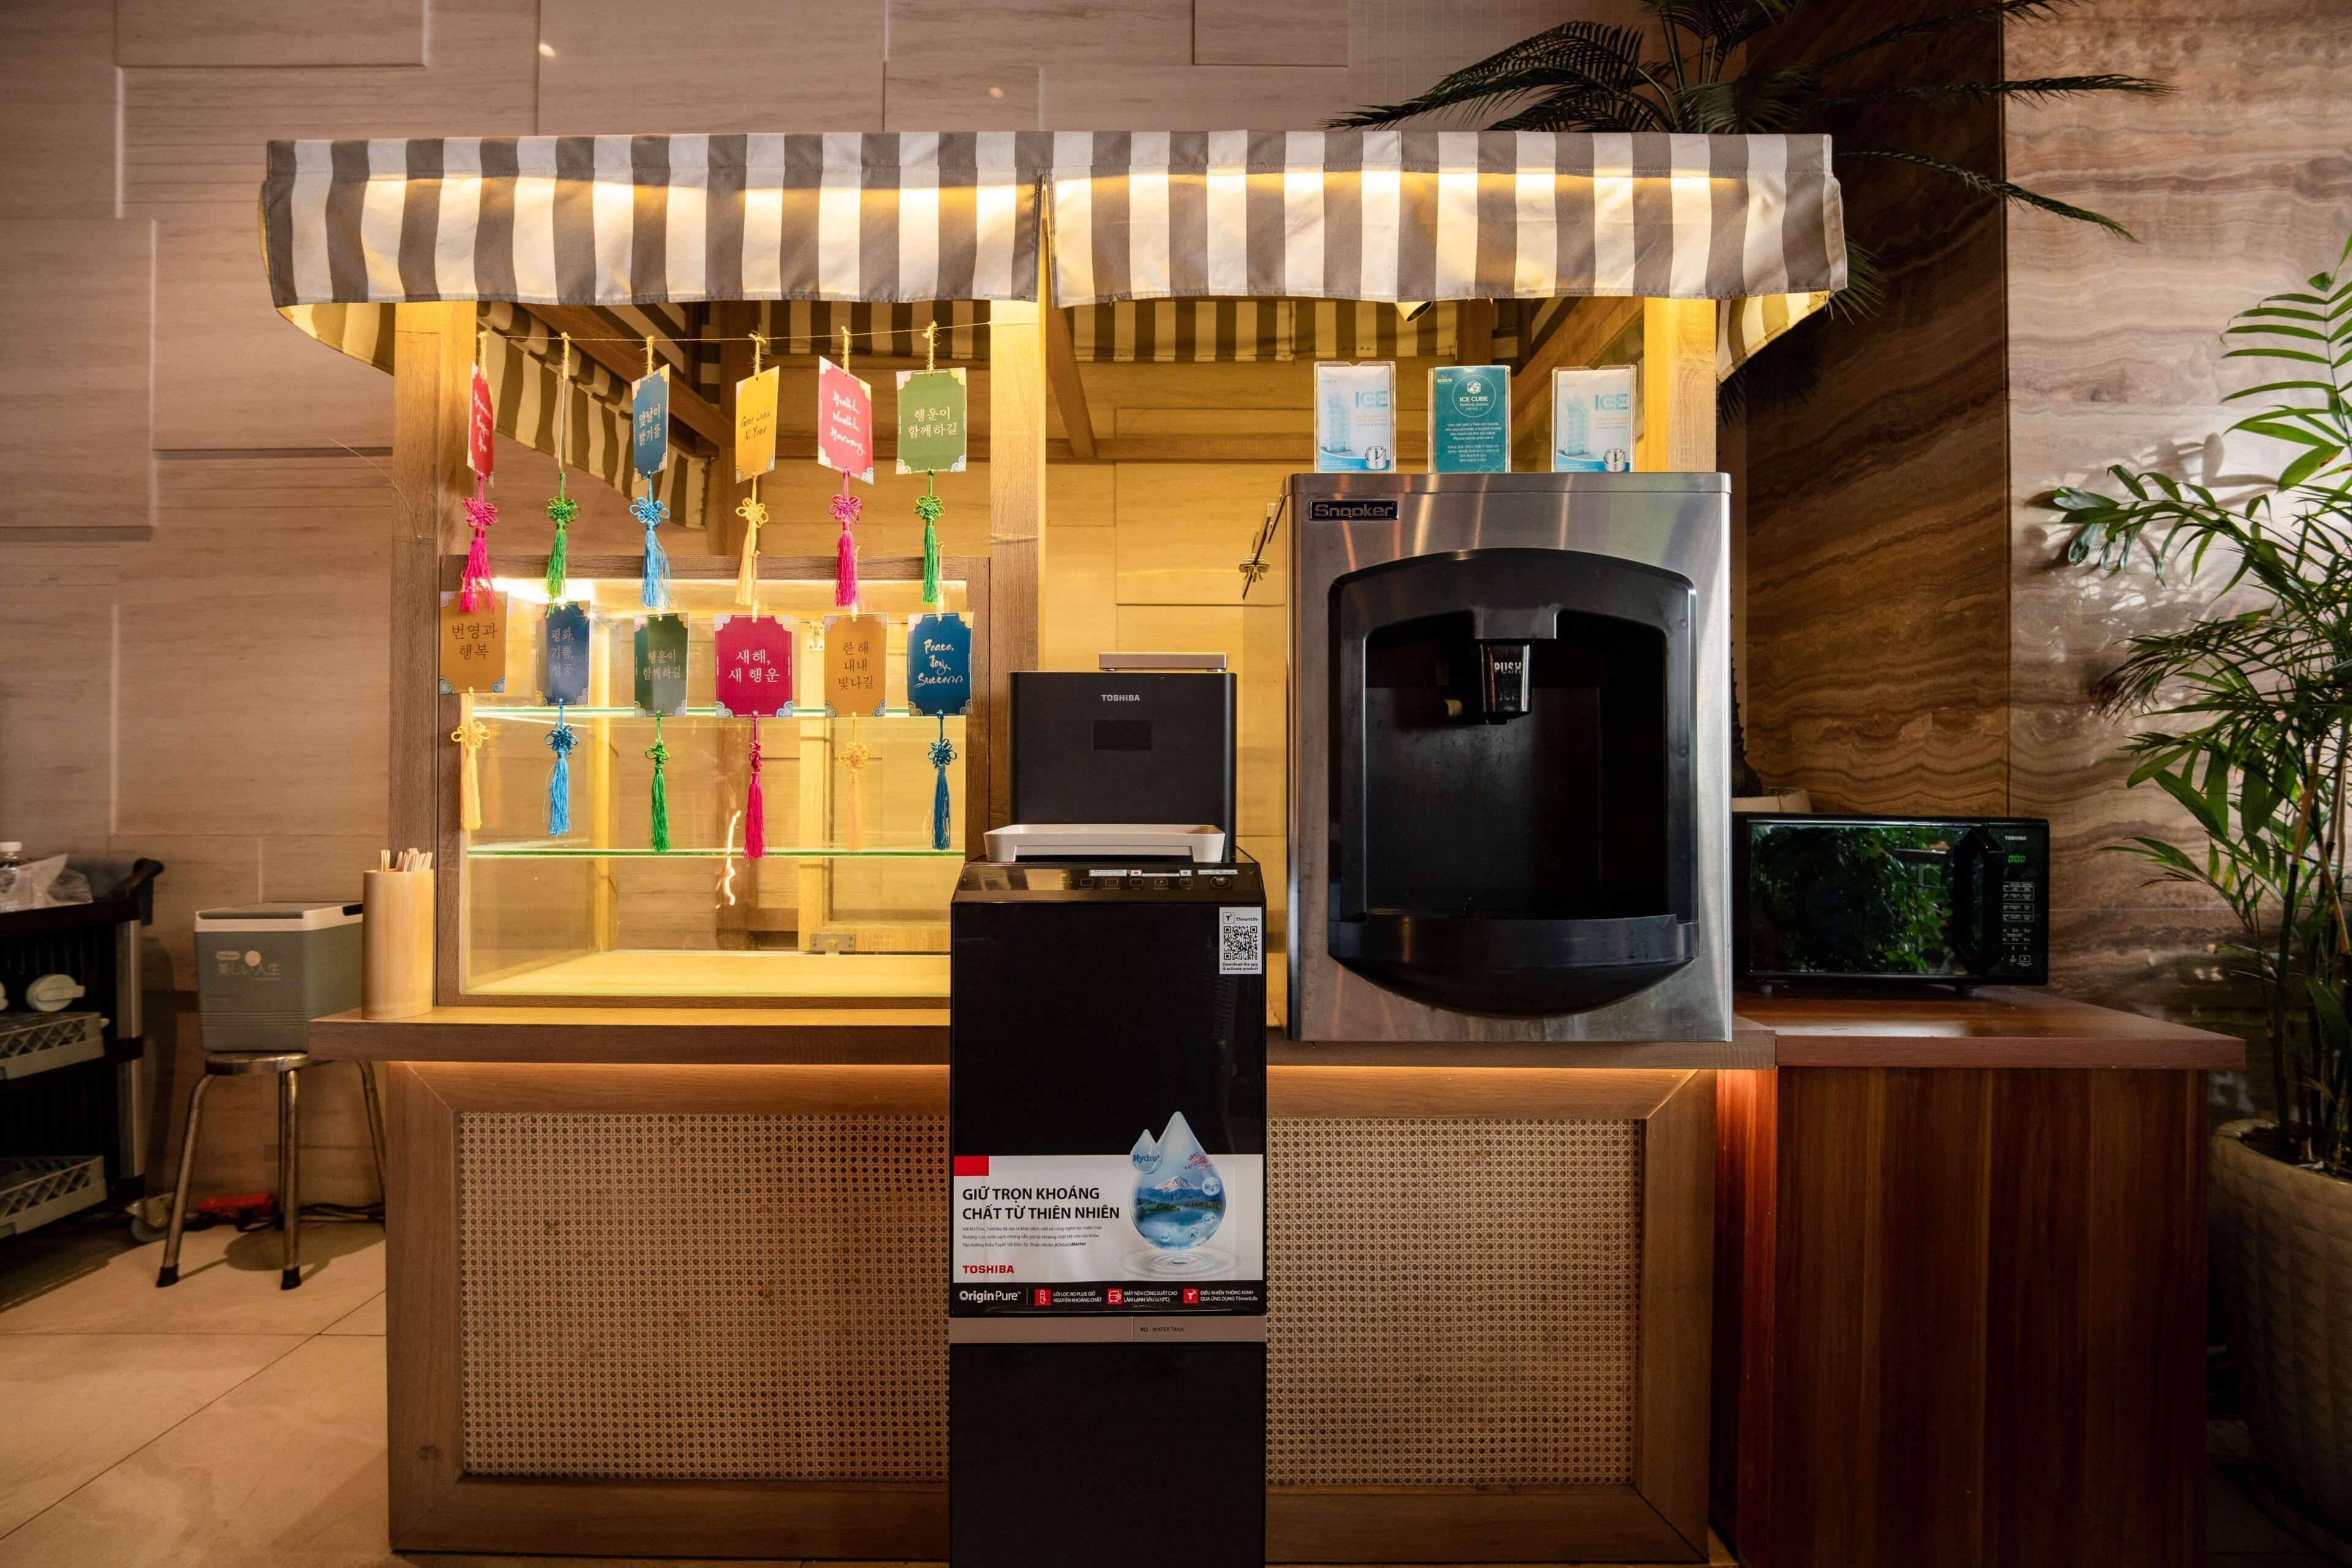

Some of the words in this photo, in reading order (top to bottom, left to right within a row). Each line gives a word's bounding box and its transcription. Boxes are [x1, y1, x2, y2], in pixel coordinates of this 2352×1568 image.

[1355, 390, 1388, 407] ICE
[1595, 393, 1628, 410] ICE
[639, 403, 660, 428] 앞날이
[914, 407, 949, 421] 행운이
[639, 423, 661, 446] 밝기를
[908, 422, 957, 439] 함께하길
[1314, 503, 1393, 516] Snooker
[451, 622, 497, 639] 번영과
[551, 627, 574, 643] 평화,
[459, 644, 489, 660] 행복
[551, 646, 574, 660] 기쁨,
[924, 639, 954, 654] Peace,
[647, 649, 676, 663] 행운이
[736, 649, 770, 665] 새해,
[553, 663, 573, 677] 성공
[643, 665, 680, 680] 함께하길
[844, 658, 867, 673] 내내
[1494, 662, 1521, 674] PUSH
[728, 668, 741, 683] 새
[748, 668, 780, 683] 행운
[914, 673, 963, 688] Success
[838, 676, 873, 691] 빛나길
[962, 1186, 989, 1200] GIỮ
[992, 1188, 1032, 1203] TRỌN
[1036, 1185, 1099, 1200] KHOÁNG
[962, 1204, 1001, 1219] CHẤT
[1005, 1205, 1025, 1219] TỪ
[1028, 1205, 1071, 1219] THIÊN
[1075, 1204, 1120, 1219] NHIÊN
[962, 1265, 1014, 1273] TOSHIBA
